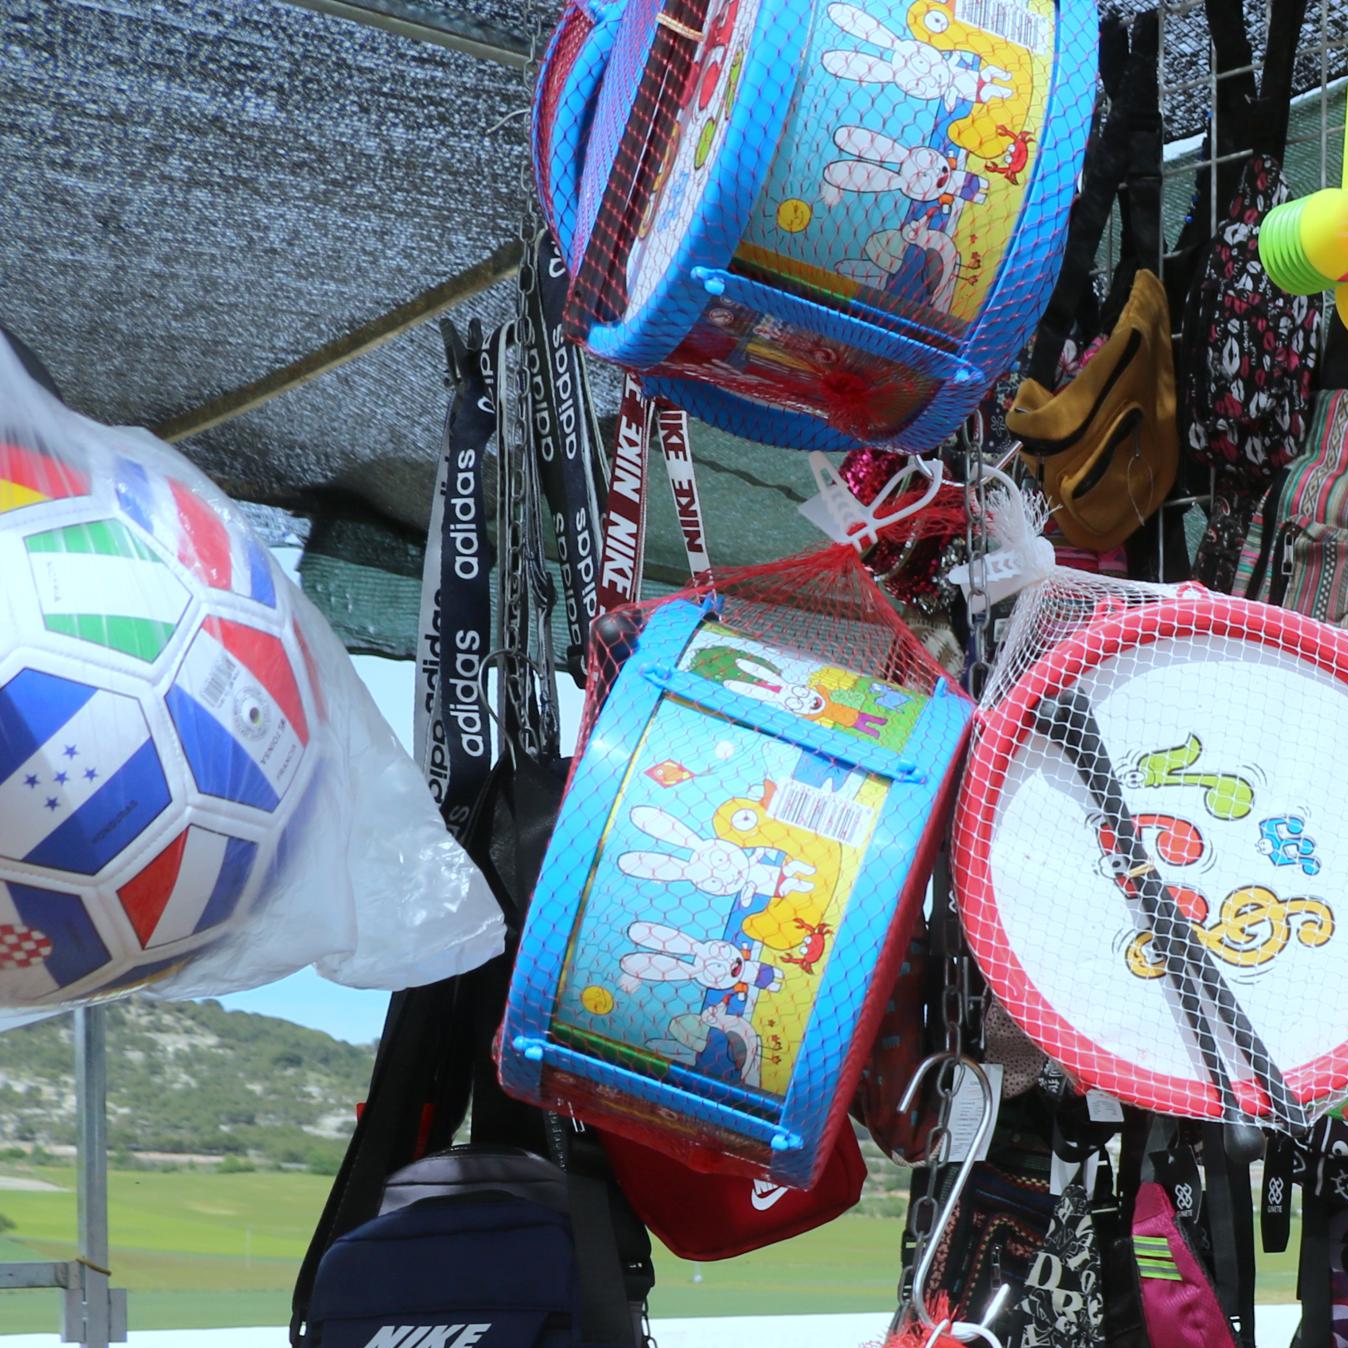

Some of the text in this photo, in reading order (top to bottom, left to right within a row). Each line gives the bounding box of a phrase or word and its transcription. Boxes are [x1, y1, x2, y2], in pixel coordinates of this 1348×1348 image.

[550, 322, 577, 461] adidas
[612, 415, 643, 504] NIKE
[449, 448, 480, 581] adidas
[602, 510, 638, 600] NIKE
[672, 478, 704, 553] NIKE
[449, 629, 485, 757] adidas
